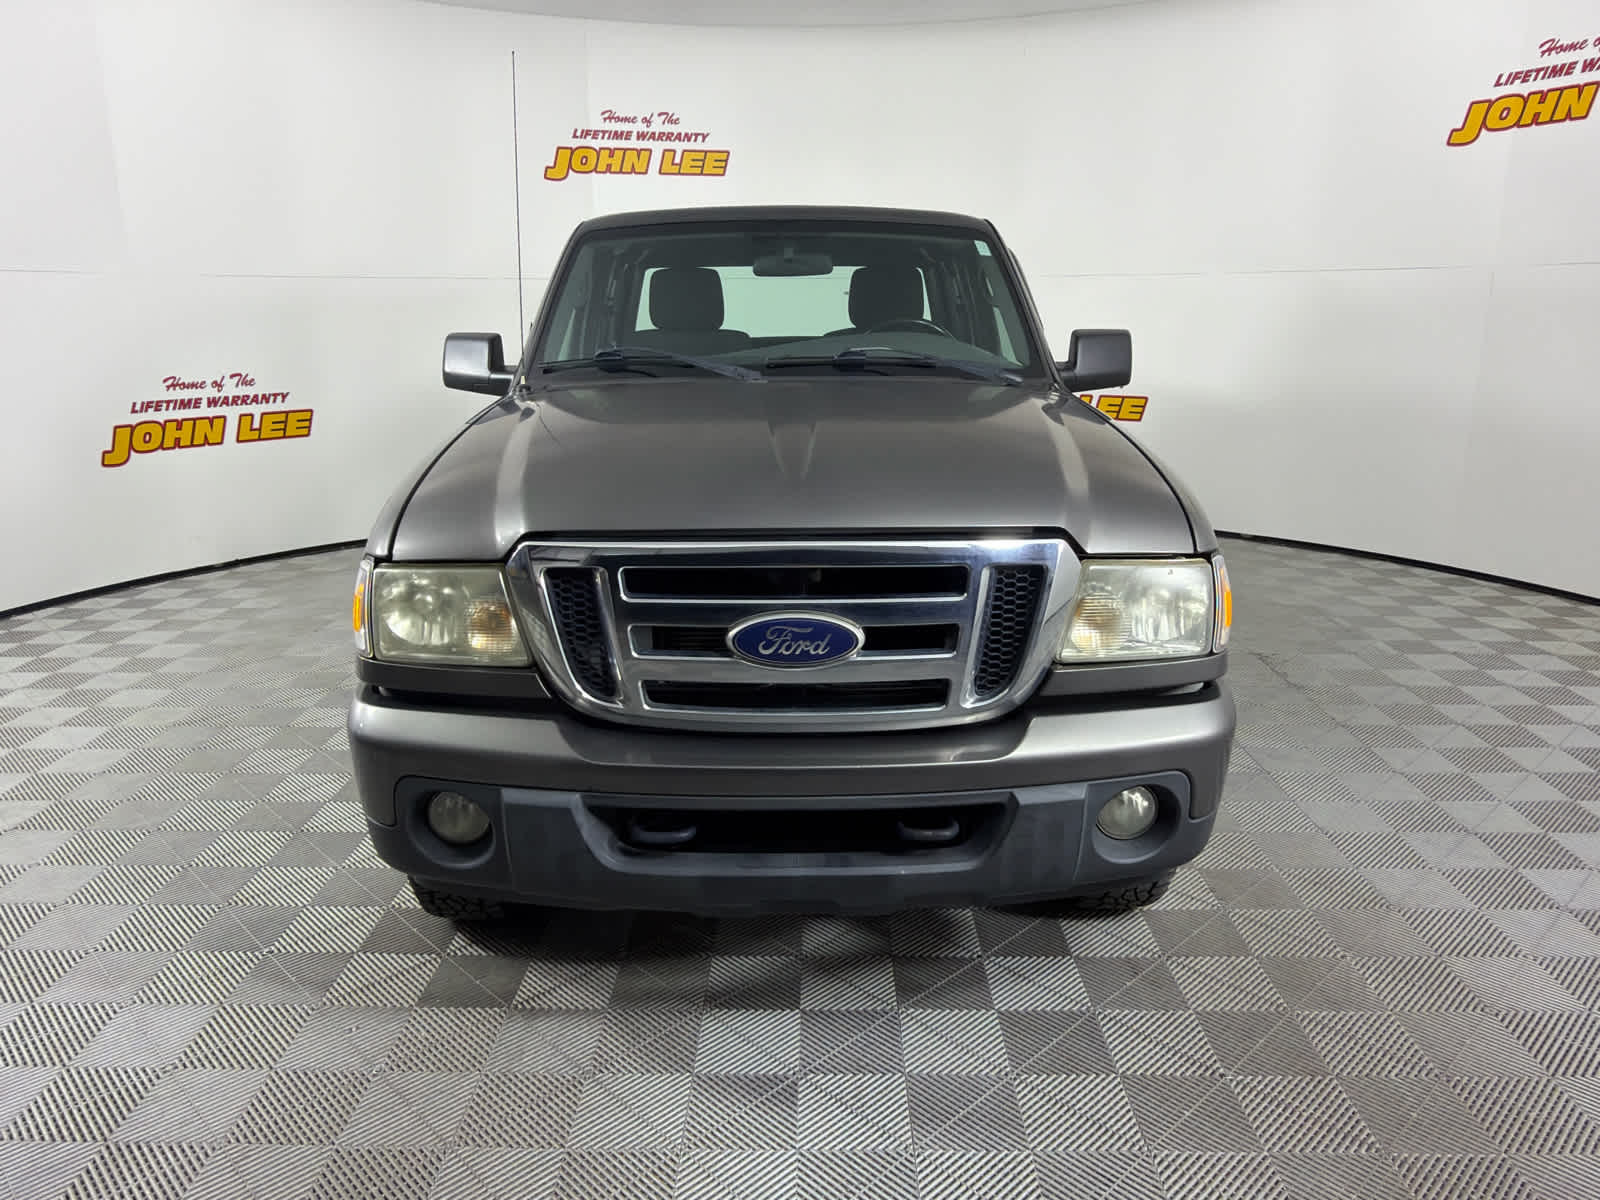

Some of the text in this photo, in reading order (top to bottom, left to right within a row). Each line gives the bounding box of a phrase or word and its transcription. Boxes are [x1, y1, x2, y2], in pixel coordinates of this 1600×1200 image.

[1538, 38, 1588, 57] Home
[1493, 60, 1579, 88] LIFETIME
[600, 109, 681, 128] Home of The
[1446, 80, 1600, 147] JOHN
[572, 128, 710, 143] LIFETIME WARRANTY
[543, 146, 730, 181] JOHN LEE
[162, 372, 256, 392] Home of The
[130, 391, 290, 414] LIFETIME WARRANTY
[1079, 394, 1149, 422] EE
[101, 408, 314, 468] JOHN LEE
[757, 625, 831, 655] Ford
